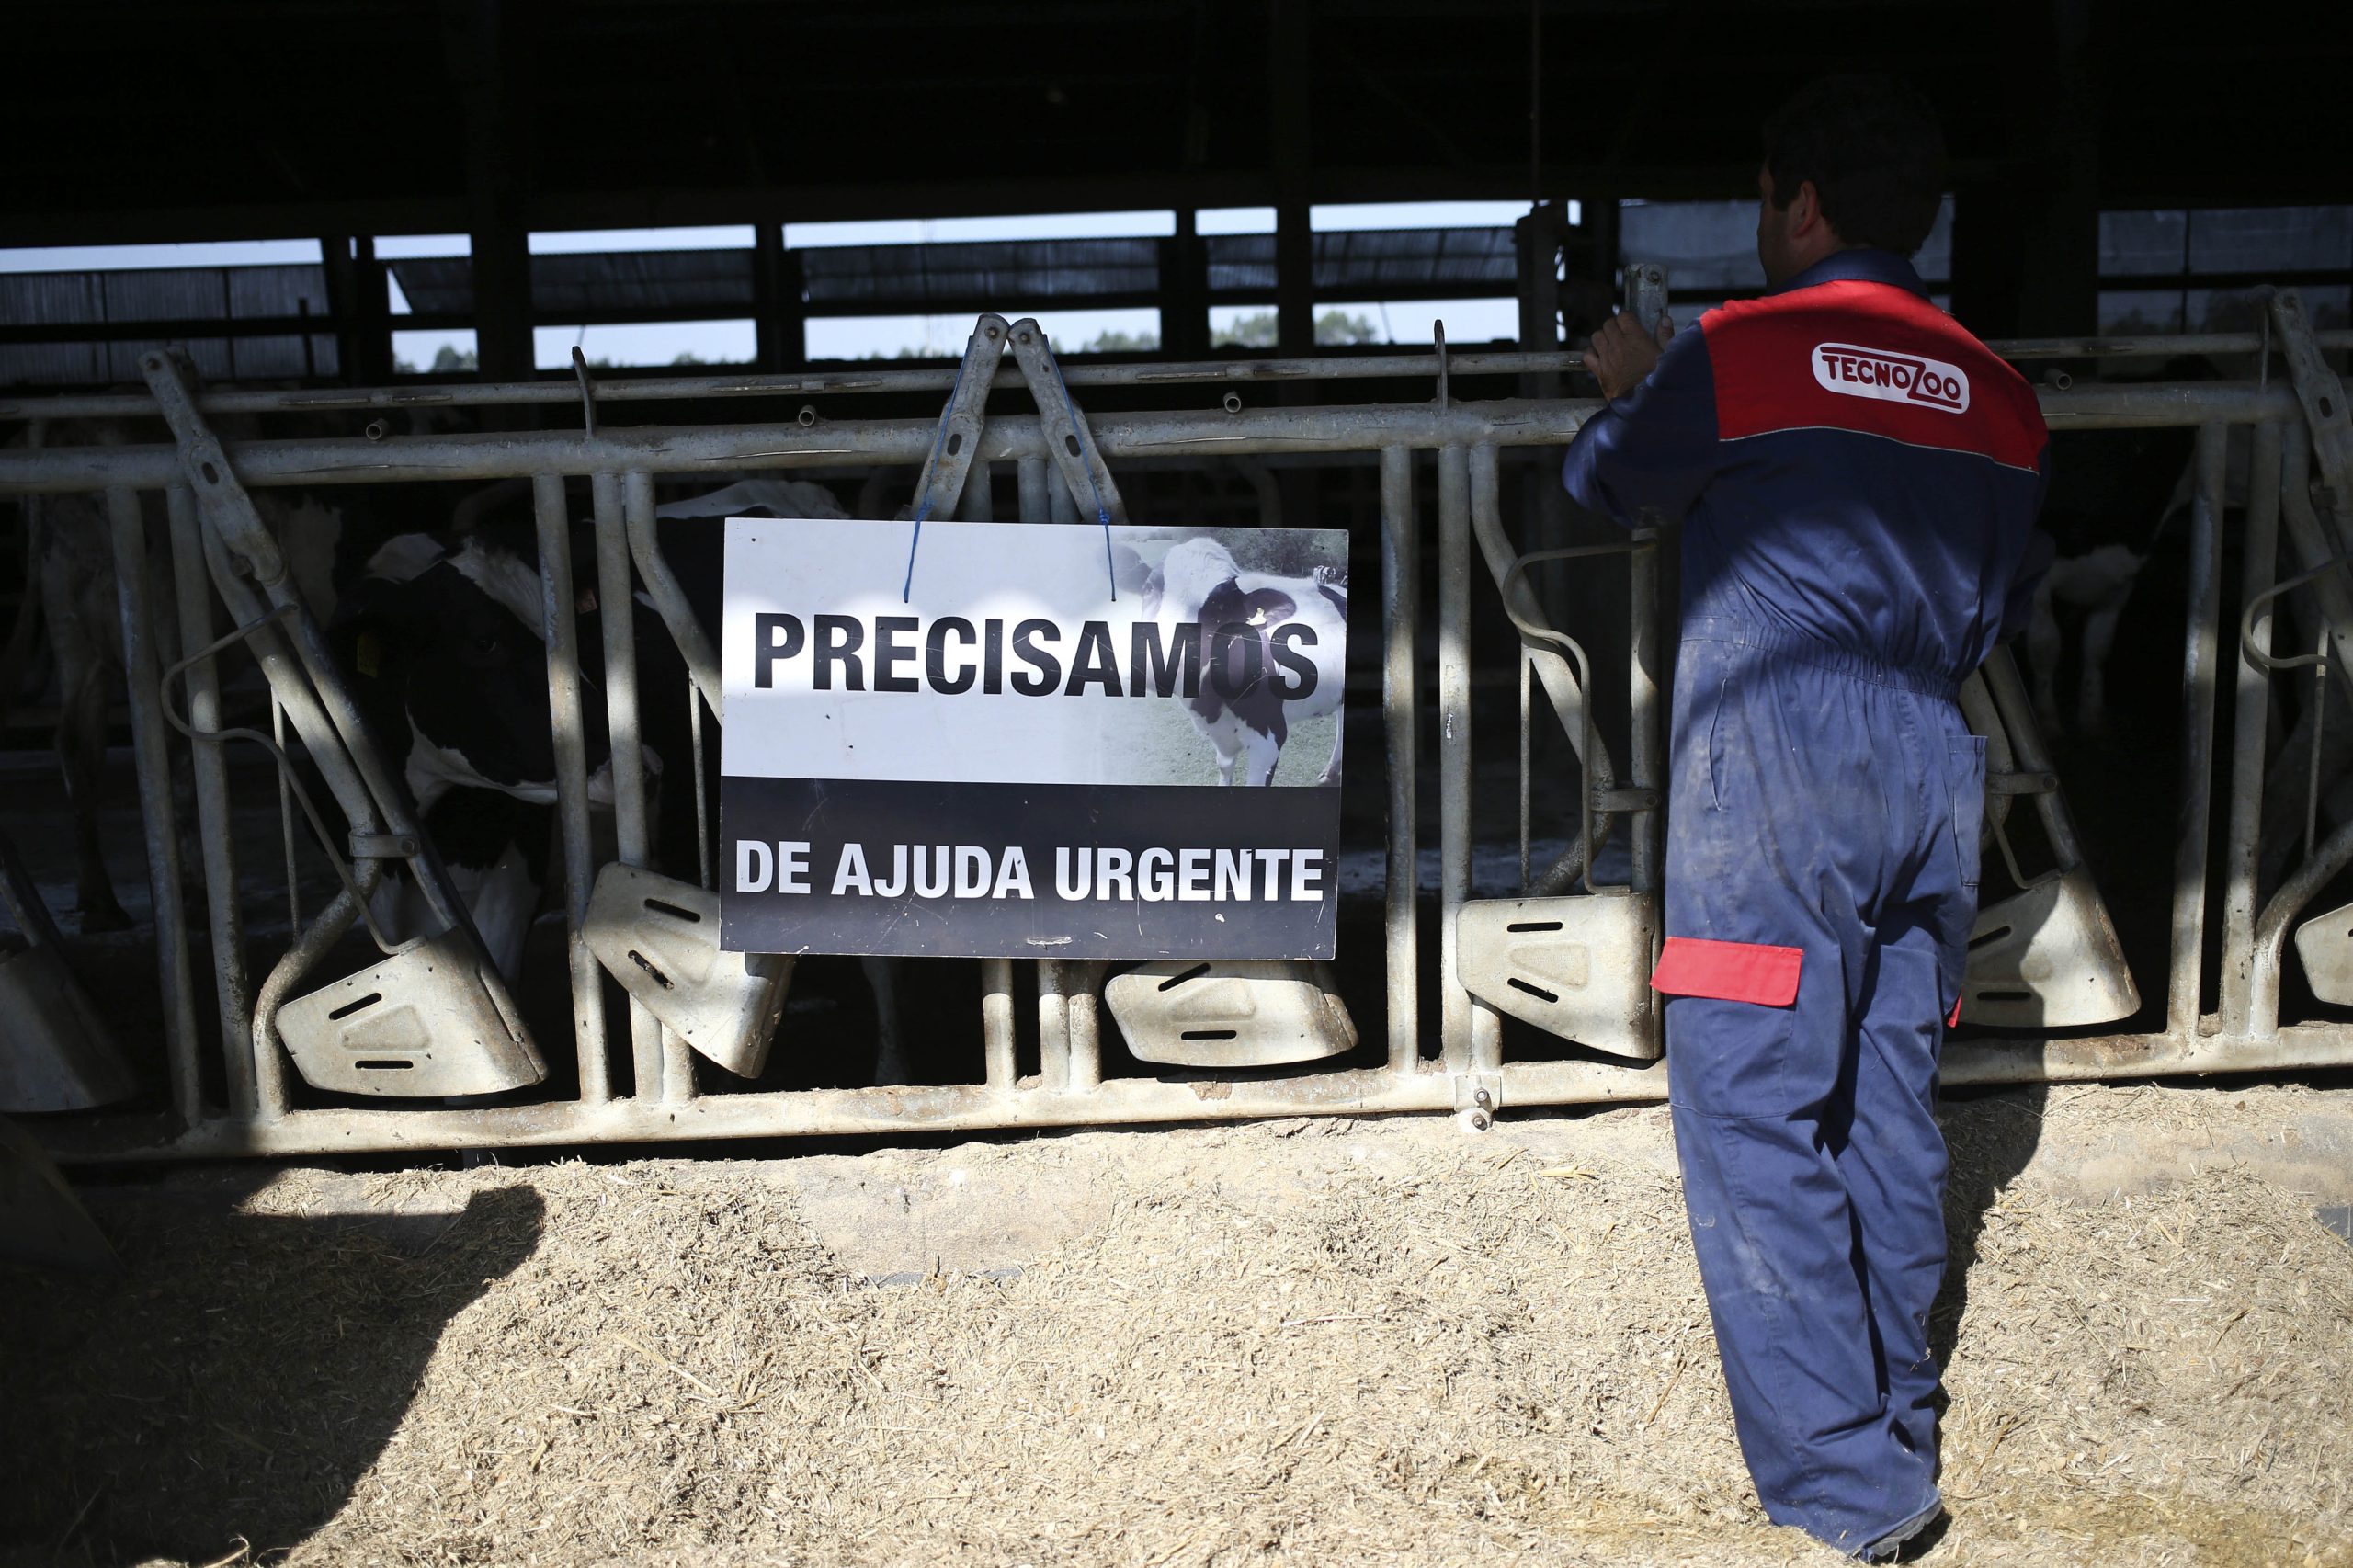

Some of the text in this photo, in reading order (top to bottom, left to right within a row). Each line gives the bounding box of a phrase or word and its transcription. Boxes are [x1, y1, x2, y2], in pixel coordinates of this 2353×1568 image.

[1820, 346, 1962, 409] TECNOZOO
[754, 612, 1319, 700] PRECISAMOS
[736, 839, 1324, 902] DE AJUDA URGENTE
